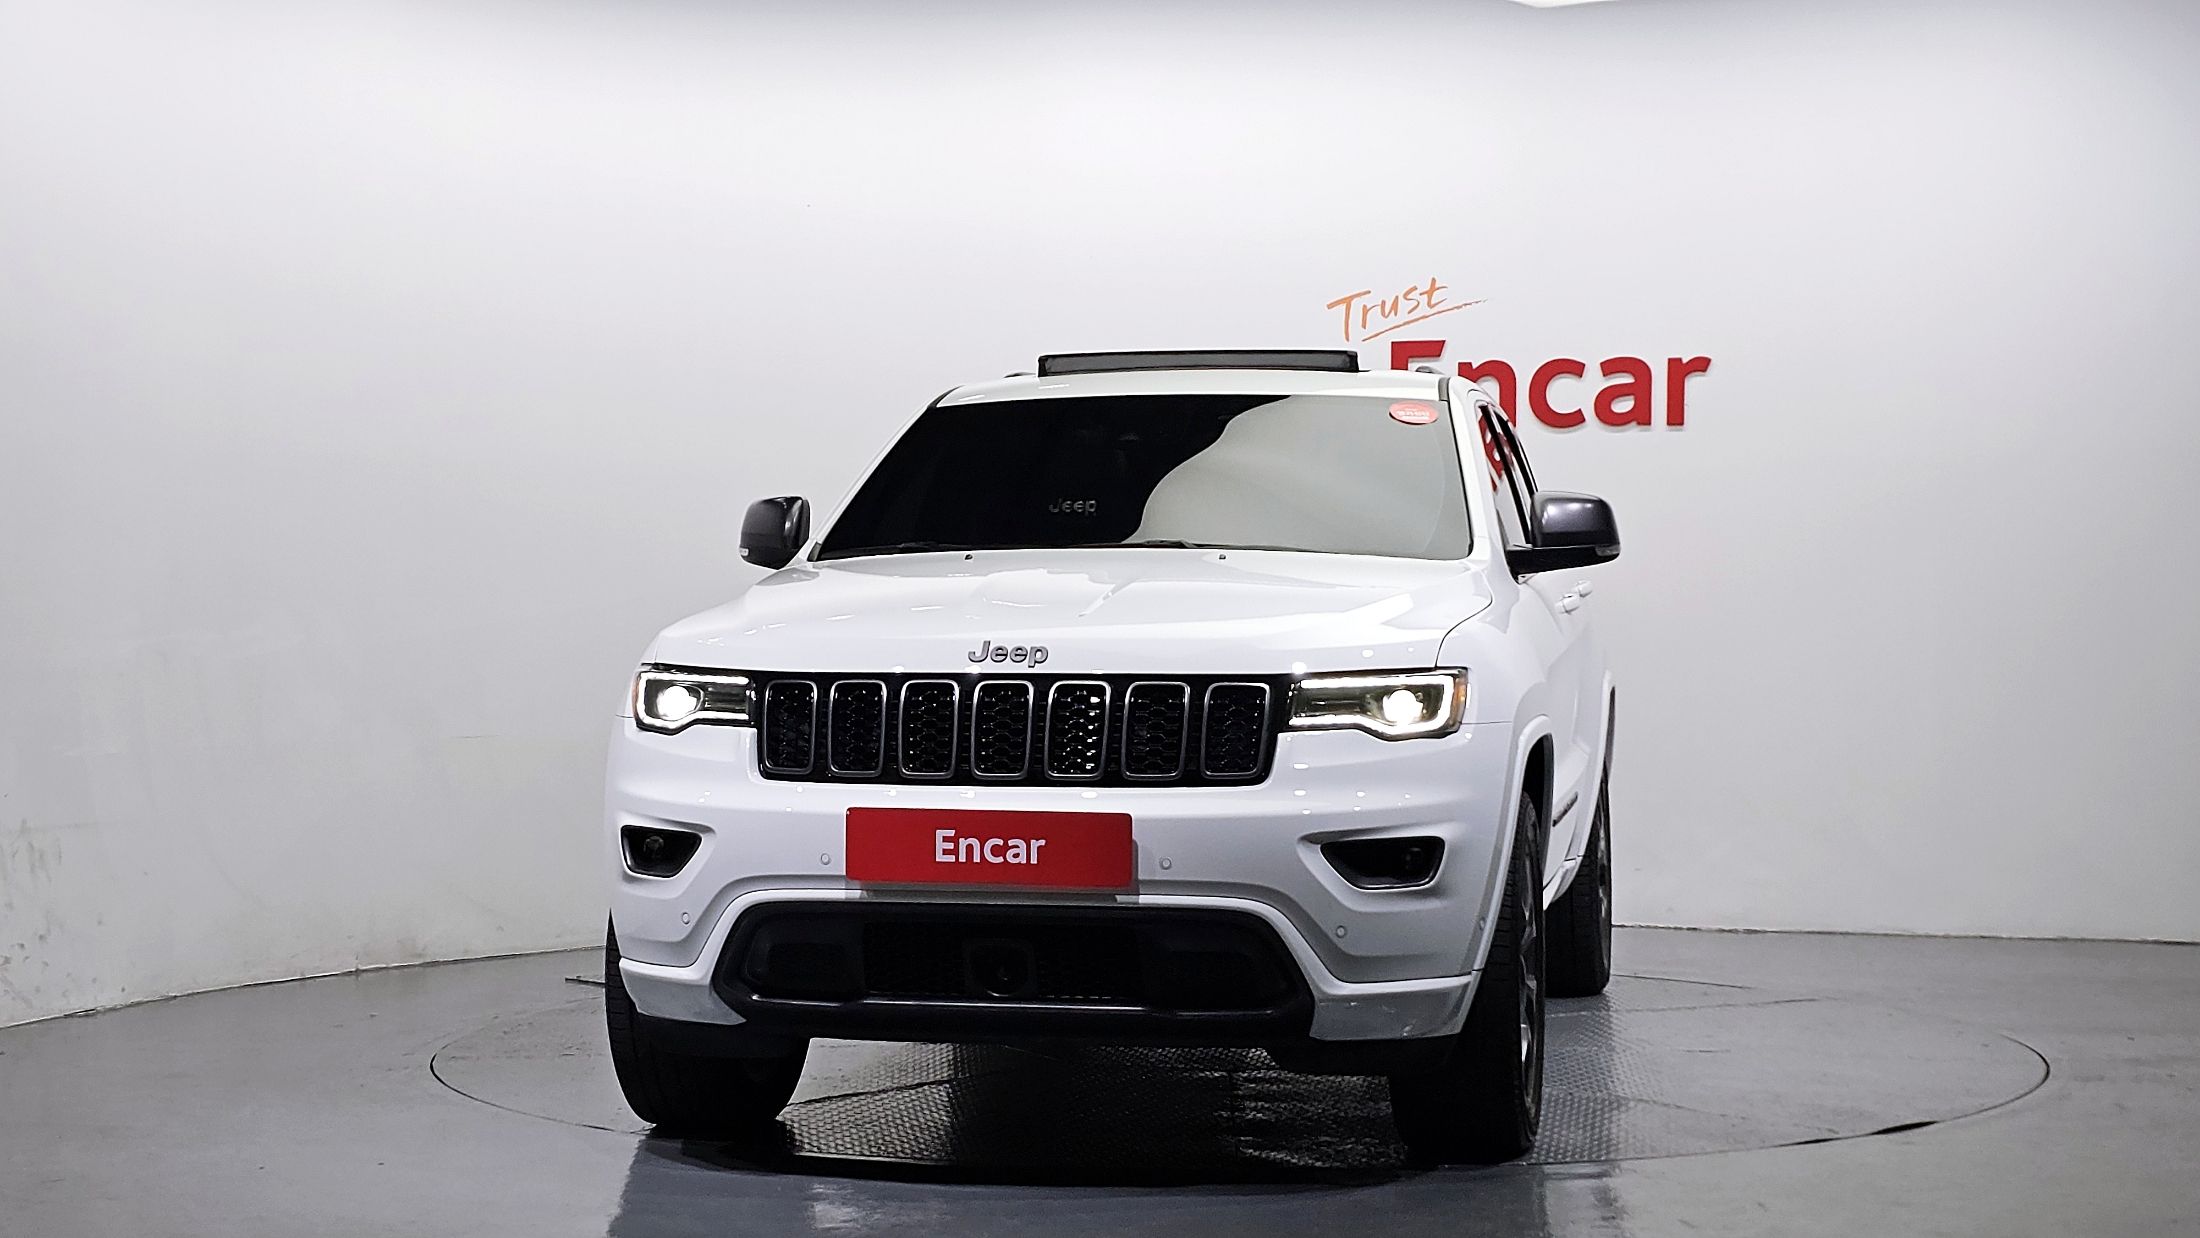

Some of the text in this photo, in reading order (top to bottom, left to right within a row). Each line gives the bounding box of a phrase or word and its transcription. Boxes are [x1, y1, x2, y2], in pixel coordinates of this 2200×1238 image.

[1326, 277, 1448, 341] Trust
[1048, 497, 1098, 516] Jeep
[967, 640, 1049, 668] Jeep
[935, 829, 1046, 864] Encar
